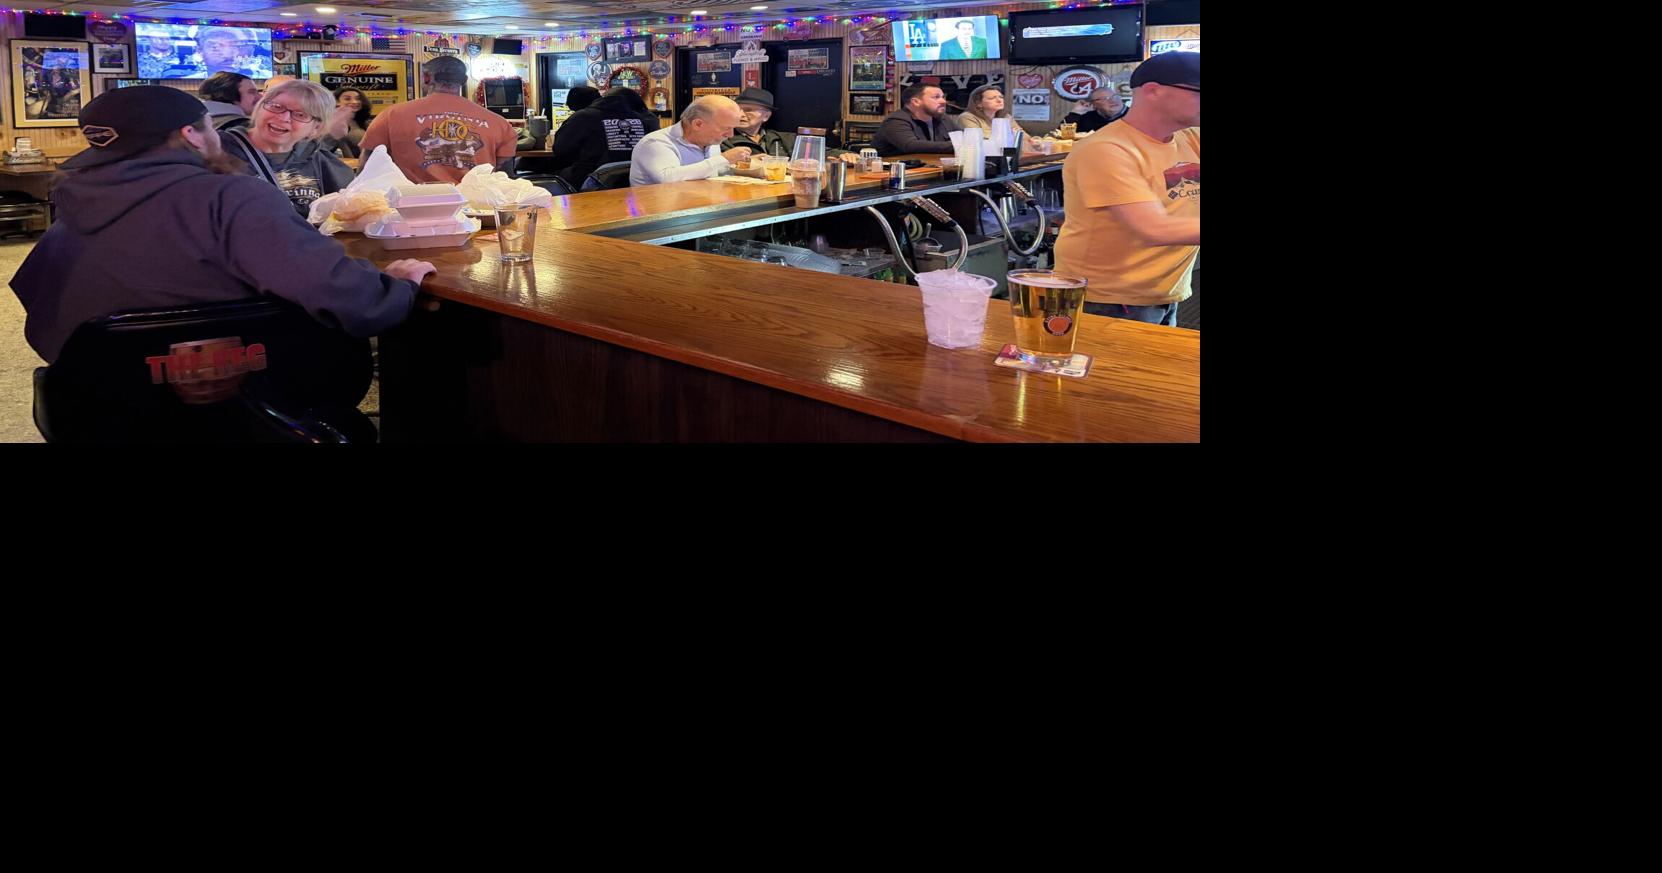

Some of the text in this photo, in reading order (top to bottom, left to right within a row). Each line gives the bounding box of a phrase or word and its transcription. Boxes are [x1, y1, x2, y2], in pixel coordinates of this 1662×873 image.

[908, 23, 925, 44] LA
[341, 64, 381, 74] Miller
[325, 76, 394, 84] GENUINE
[1019, 95, 1044, 104] NO
